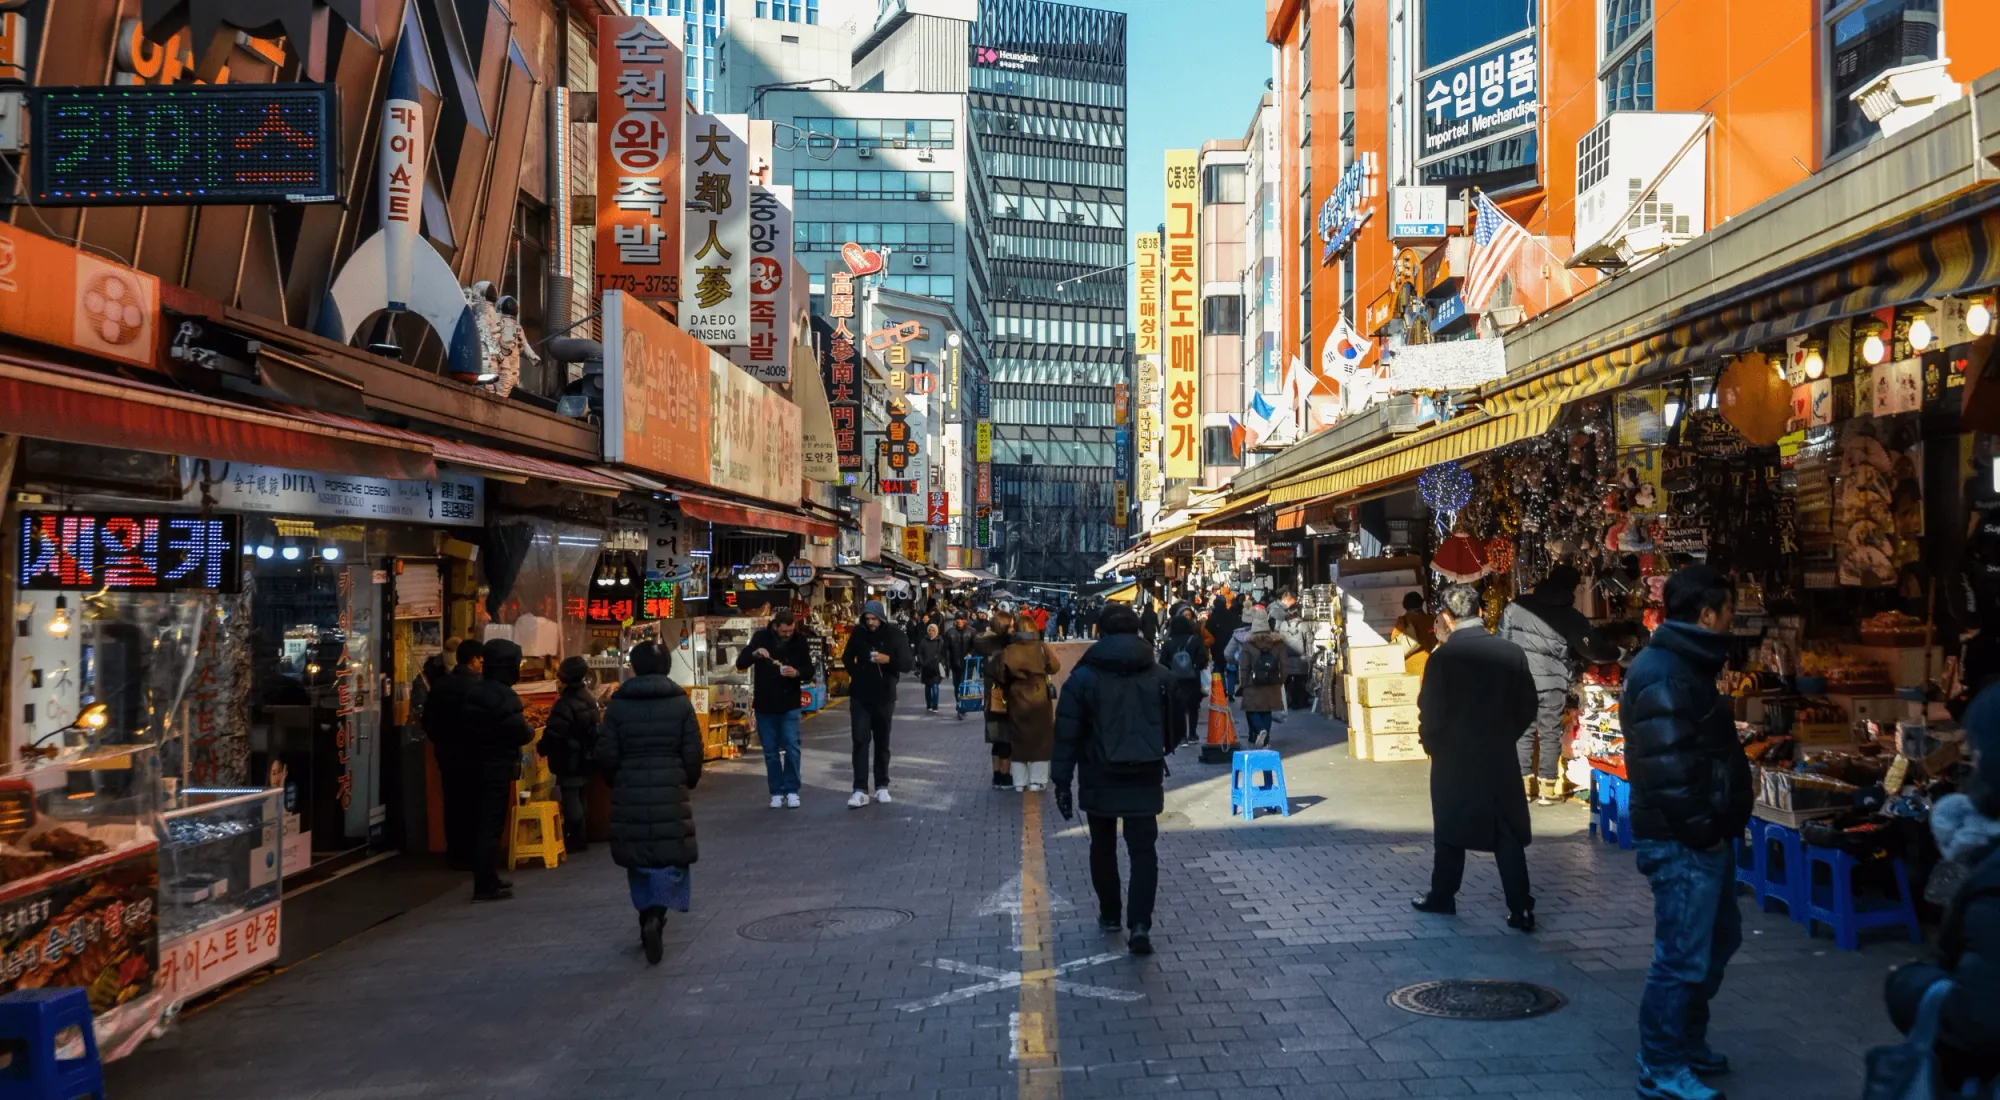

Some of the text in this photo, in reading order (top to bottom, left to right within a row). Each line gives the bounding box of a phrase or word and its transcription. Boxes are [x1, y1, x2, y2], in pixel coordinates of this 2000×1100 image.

[999, 50, 1039, 64] Heungkuk
[1426, 44, 1536, 126] 수입명품
[612, 21, 668, 264] 순천왕족발
[1426, 98, 1537, 149] Imported Merchandise
[388, 106, 417, 222] 카이스트
[1399, 225, 1427, 235] TOILET
[611, 275, 678, 293] 773-3755
[1139, 252, 1156, 350] 그릇도매상가
[687, 329, 737, 341] GINSENG
[690, 314, 737, 326] DAEDO
[1170, 202, 1195, 461] 그릇도매상가
[801, 451, 833, 464] 도안경
[283, 473, 317, 494] DITA
[324, 480, 363, 494] PORSCHE
[363, 482, 391, 497] DESIGN
[655, 510, 679, 578] 추어탕
[336, 565, 356, 811] 카이스트안경
[160, 906, 279, 993] 카이스트안경
